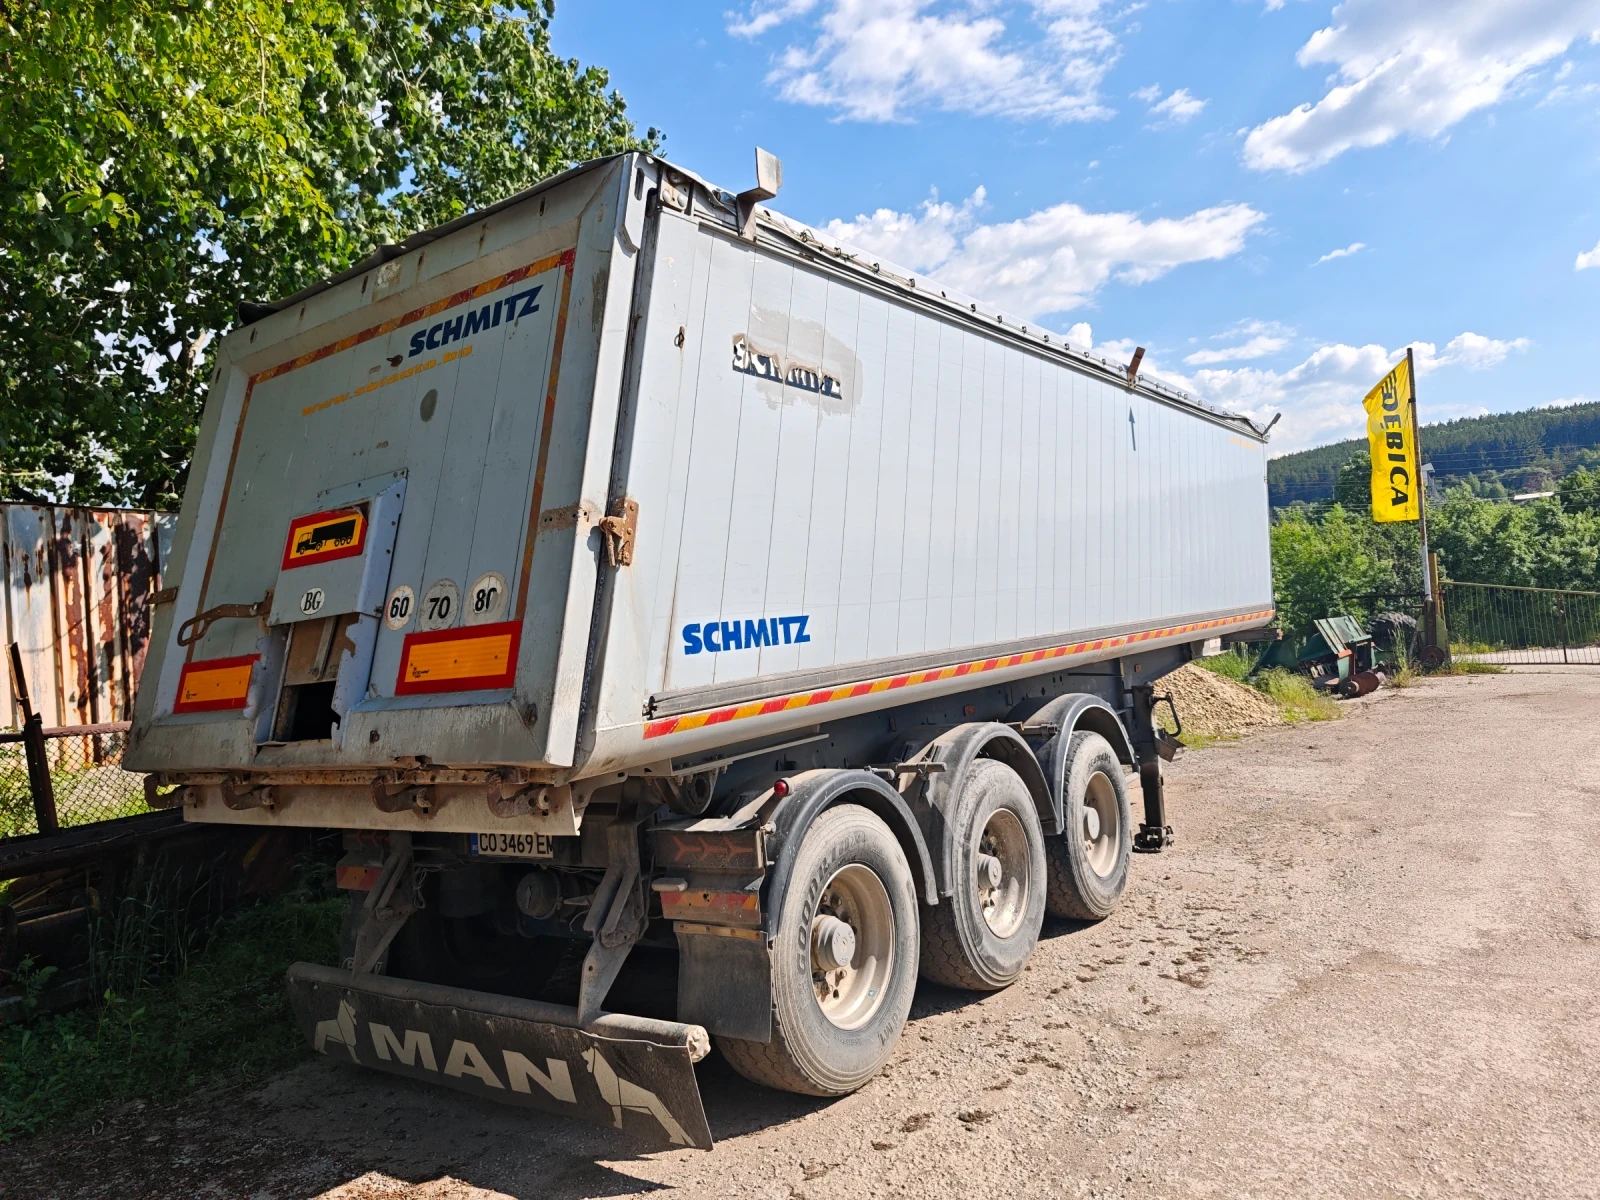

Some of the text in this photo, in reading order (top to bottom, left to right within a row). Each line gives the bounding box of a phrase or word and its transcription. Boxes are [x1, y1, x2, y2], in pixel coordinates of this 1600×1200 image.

[408, 284, 544, 357] SCHMITZ
[303, 590, 322, 612] BG
[389, 596, 409, 619] 60
[429, 595, 451, 620] 70
[682, 615, 811, 656] SCHMITZ
[500, 834, 534, 854] 3469
[368, 1021, 578, 1104] MAN
